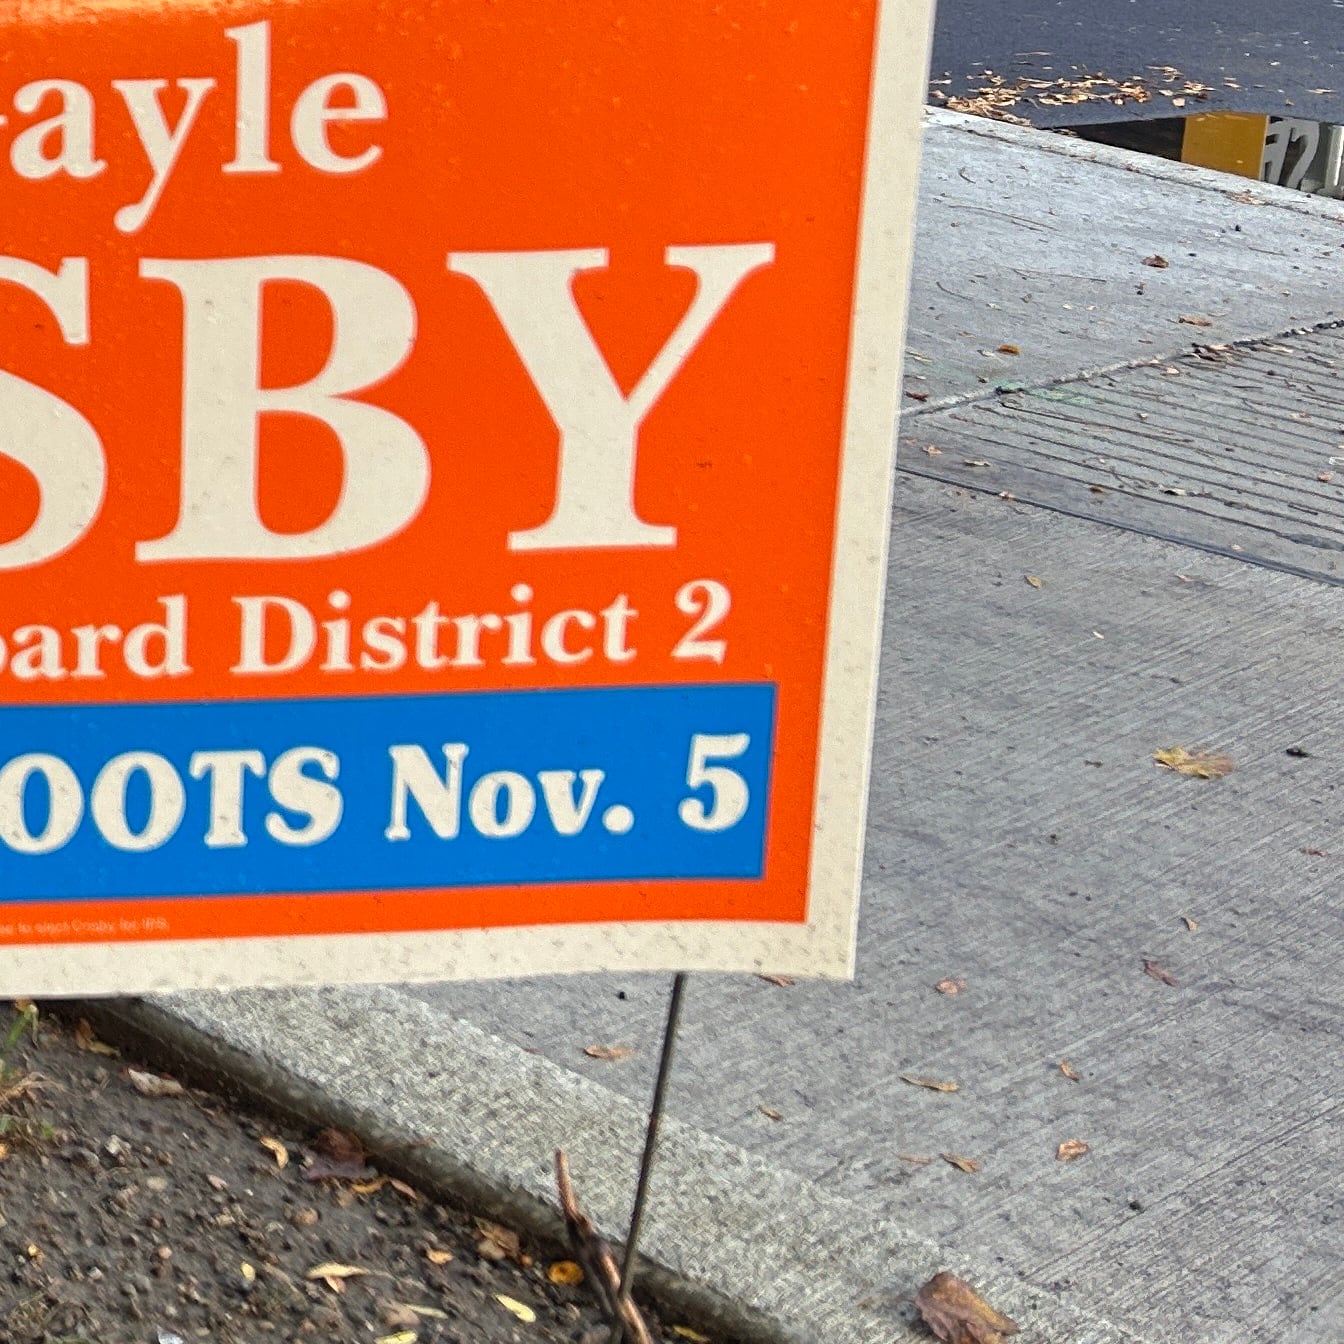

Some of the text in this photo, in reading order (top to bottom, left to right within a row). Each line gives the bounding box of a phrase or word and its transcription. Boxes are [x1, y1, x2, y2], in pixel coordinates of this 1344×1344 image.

[231, 583, 637, 674] District
[672, 579, 731, 664] 2
[384, 743, 635, 841] Nov.
[678, 733, 750, 831] 5
